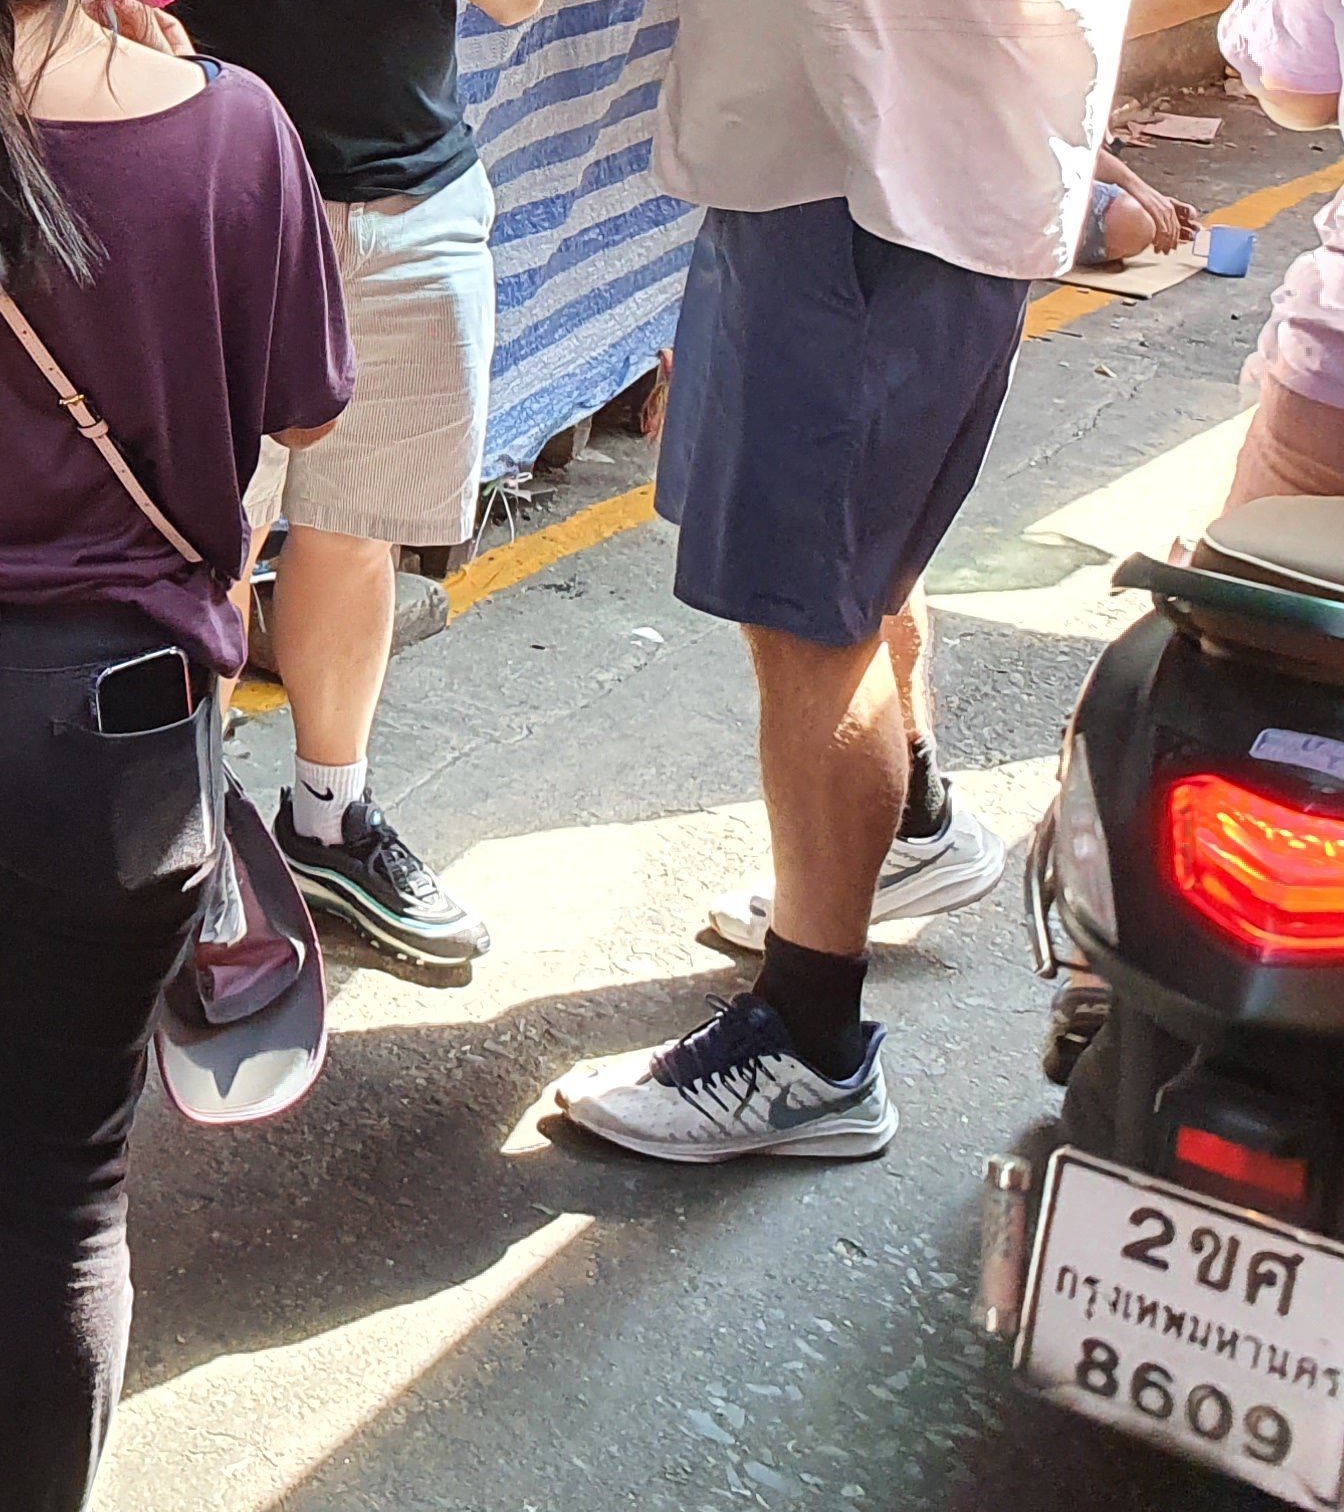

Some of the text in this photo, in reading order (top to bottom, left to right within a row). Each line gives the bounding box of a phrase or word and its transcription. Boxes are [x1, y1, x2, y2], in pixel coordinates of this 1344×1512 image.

[1121, 1206, 1305, 1317] 2ขศ
[1054, 1264, 1342, 1397] กรุงเทพมหานคร
[1075, 1337, 1294, 1465] 8609
